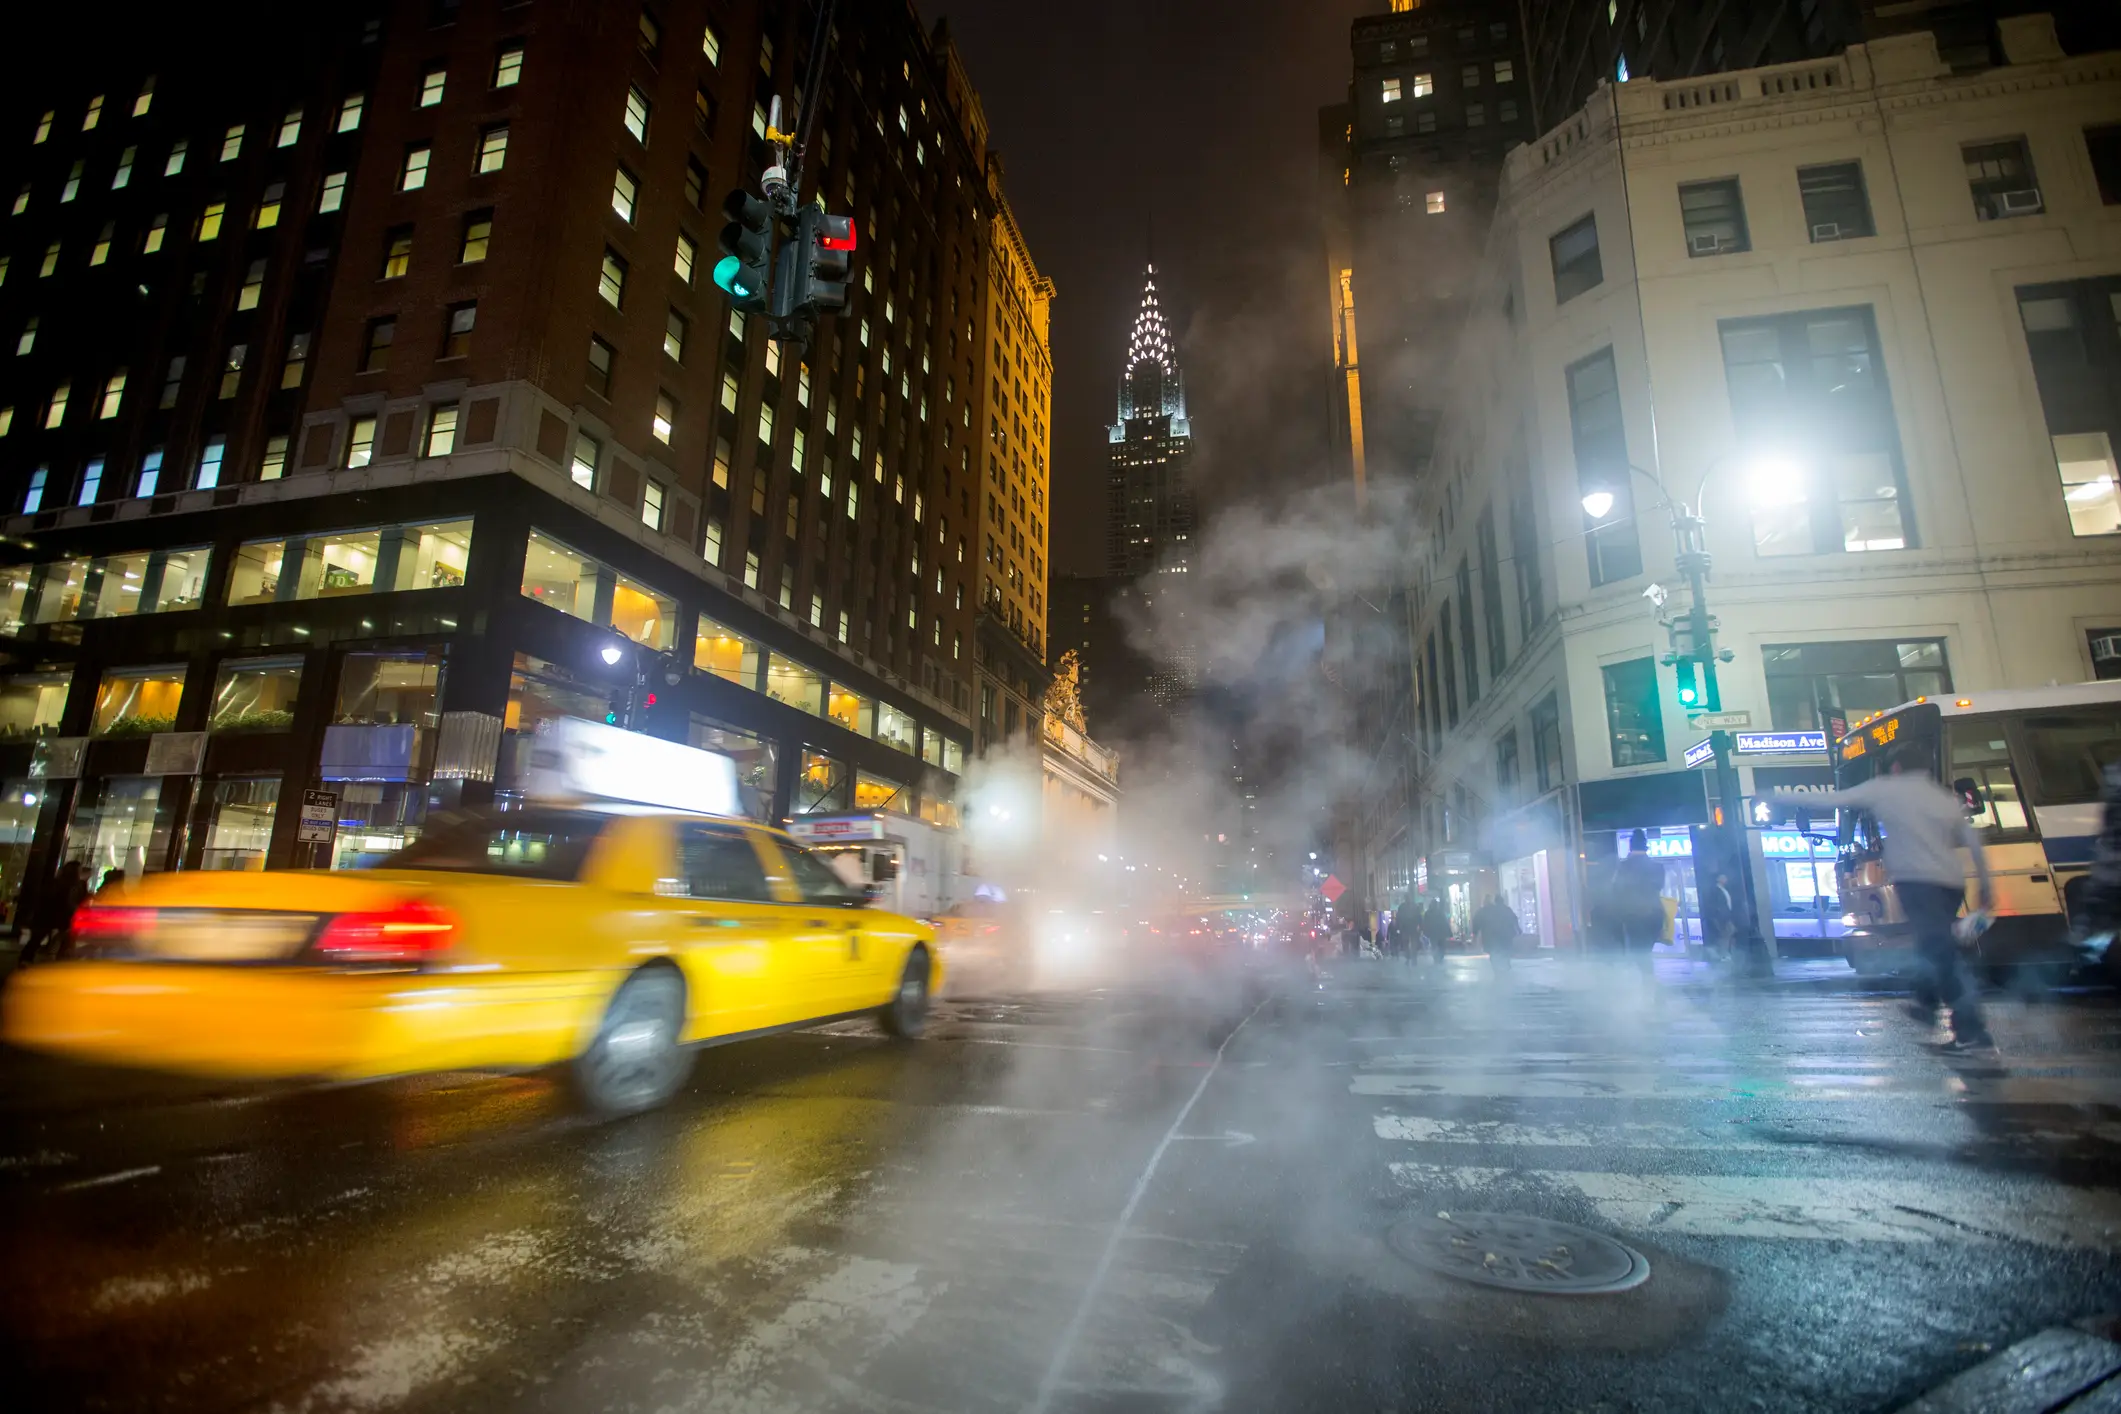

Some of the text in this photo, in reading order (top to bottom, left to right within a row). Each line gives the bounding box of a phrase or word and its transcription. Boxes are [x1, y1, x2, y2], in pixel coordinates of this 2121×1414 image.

[1698, 714, 1744, 726] ONE WAY
[1739, 736, 1825, 749] Madison Ave
